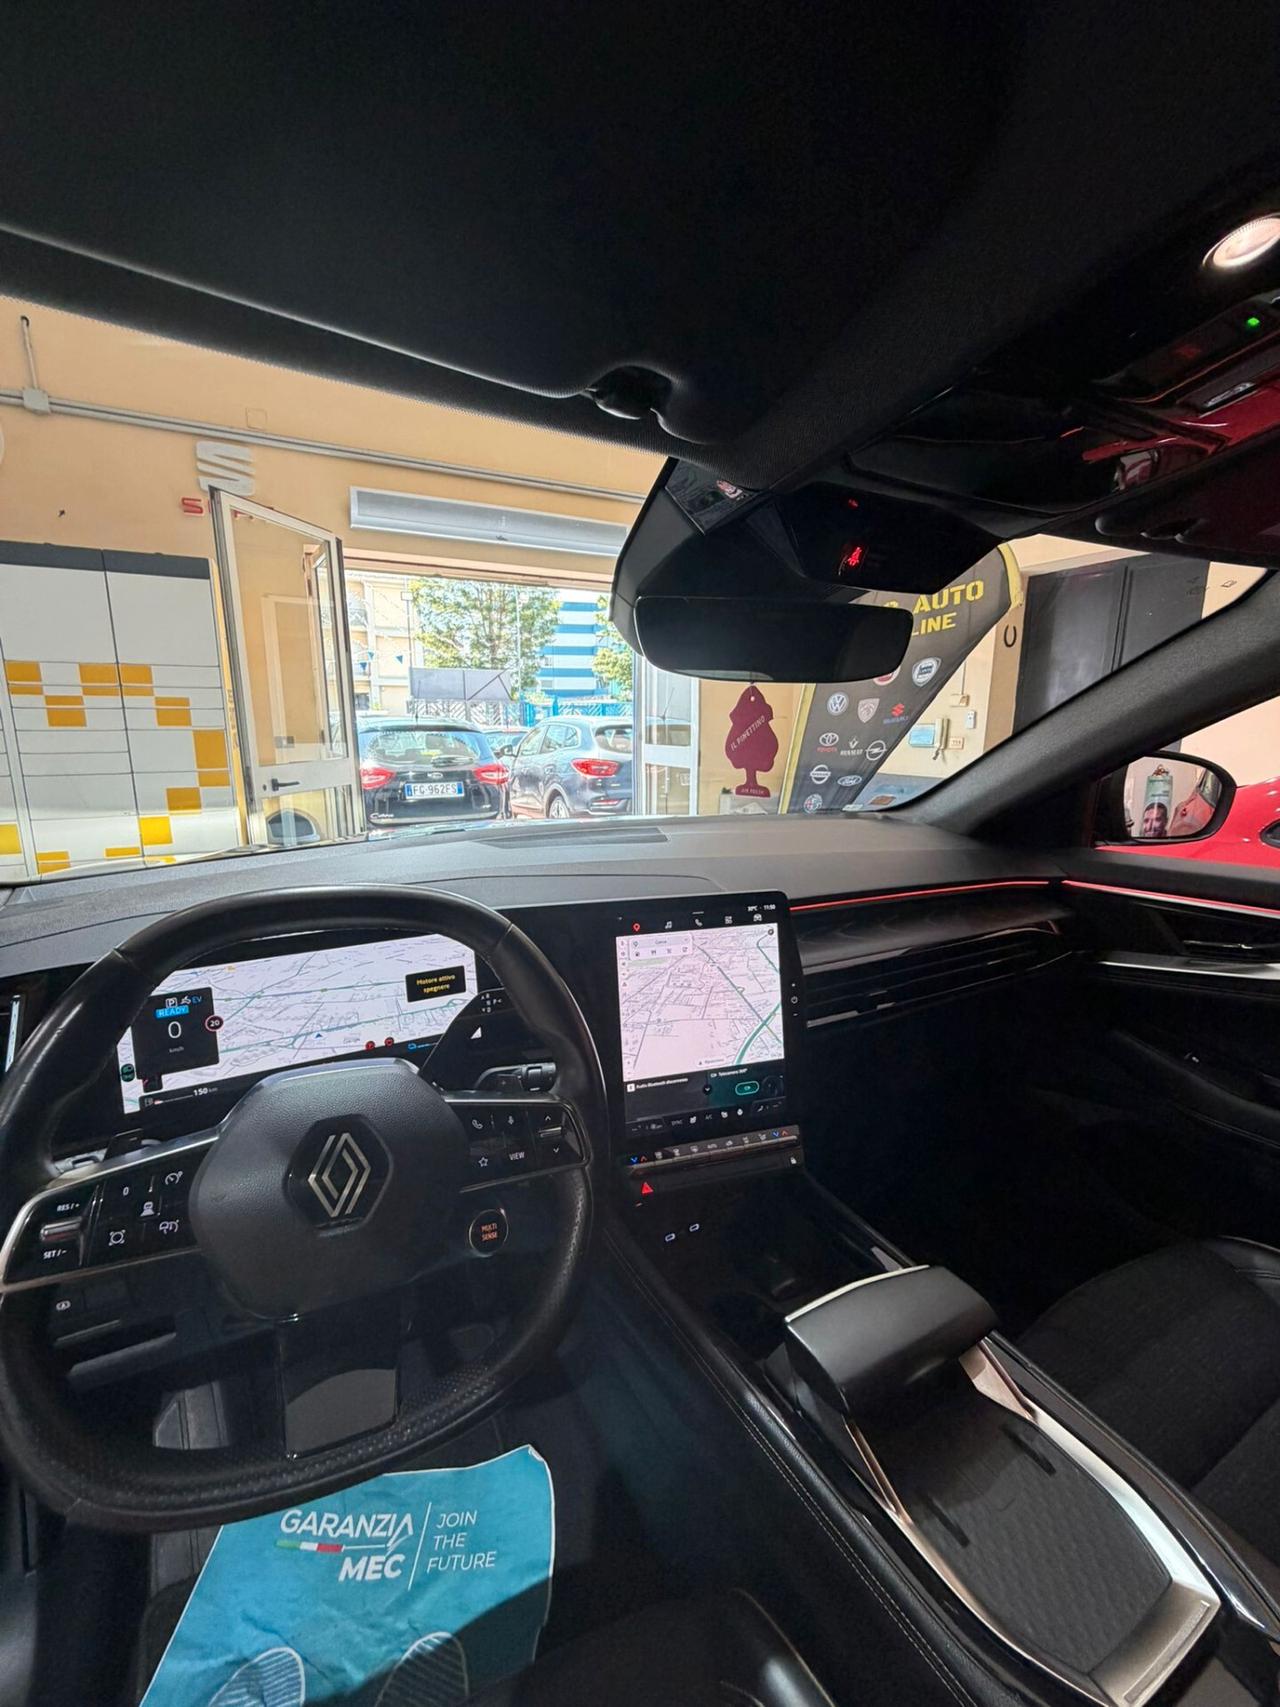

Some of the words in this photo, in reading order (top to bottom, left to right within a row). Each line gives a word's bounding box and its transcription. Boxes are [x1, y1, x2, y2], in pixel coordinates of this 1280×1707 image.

[913, 580, 984, 614] AUTO
[157, 1006, 188, 1017] READY
[168, 1021, 182, 1038] 0
[210, 1019, 220, 1027] 20
[193, 1087, 208, 1096] 150
[509, 1151, 525, 1161] VIEW
[280, 1509, 413, 1538] GARANZIA
[436, 1510, 478, 1529] JOIN
[433, 1532, 468, 1551] THE
[338, 1554, 405, 1582] MEC
[427, 1551, 497, 1574] FUTURE
